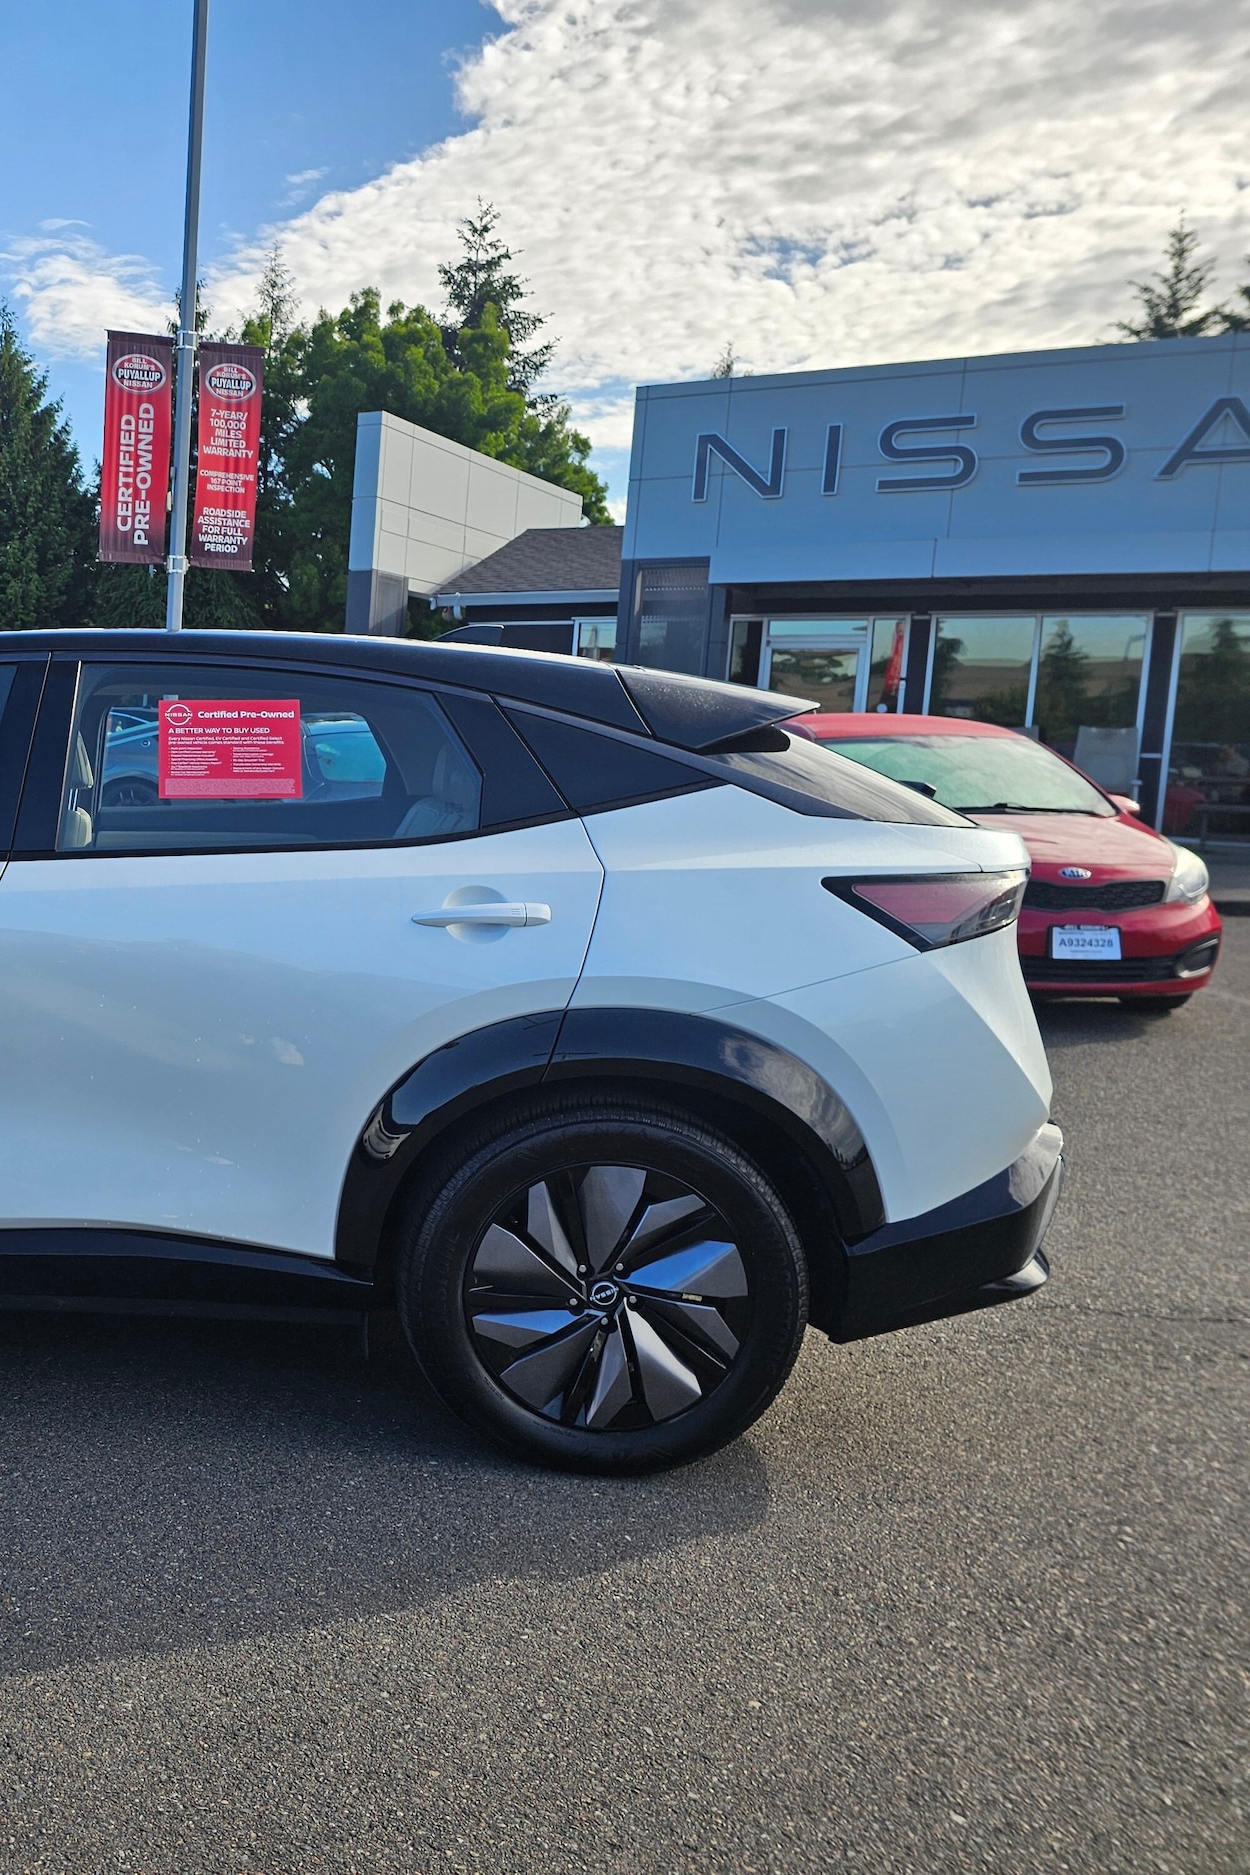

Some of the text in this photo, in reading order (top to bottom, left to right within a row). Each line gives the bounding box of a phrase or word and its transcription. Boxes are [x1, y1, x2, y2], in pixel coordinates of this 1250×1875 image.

[118, 368, 161, 382] PUYALLUP
[123, 379, 153, 389] NISSAN
[211, 377, 252, 391] PUYALLUP
[216, 388, 244, 397] NISSAN
[211, 408, 248, 421] 7-YEAR/
[210, 418, 247, 430] 100,000
[215, 428, 242, 439] MILES
[210, 436, 246, 449] LIMITED
[203, 445, 254, 459] WARRANTY
[117, 414, 136, 532] CERTIFIED
[133, 402, 155, 545] PRE-OWNED
[200, 469, 255, 481] COMPREHENSIVE
[206, 484, 245, 494] INSPECTION
[221, 479, 242, 487] POINT
[203, 507, 247, 519] ROADSIDE
[197, 515, 251, 528] ASSISTANCE
[202, 525, 243, 537] FOR FULL
[198, 533, 248, 545] WARRANTY
[204, 543, 238, 554] PERIOD
[197, 710, 295, 719] Certified Pre-Owned
